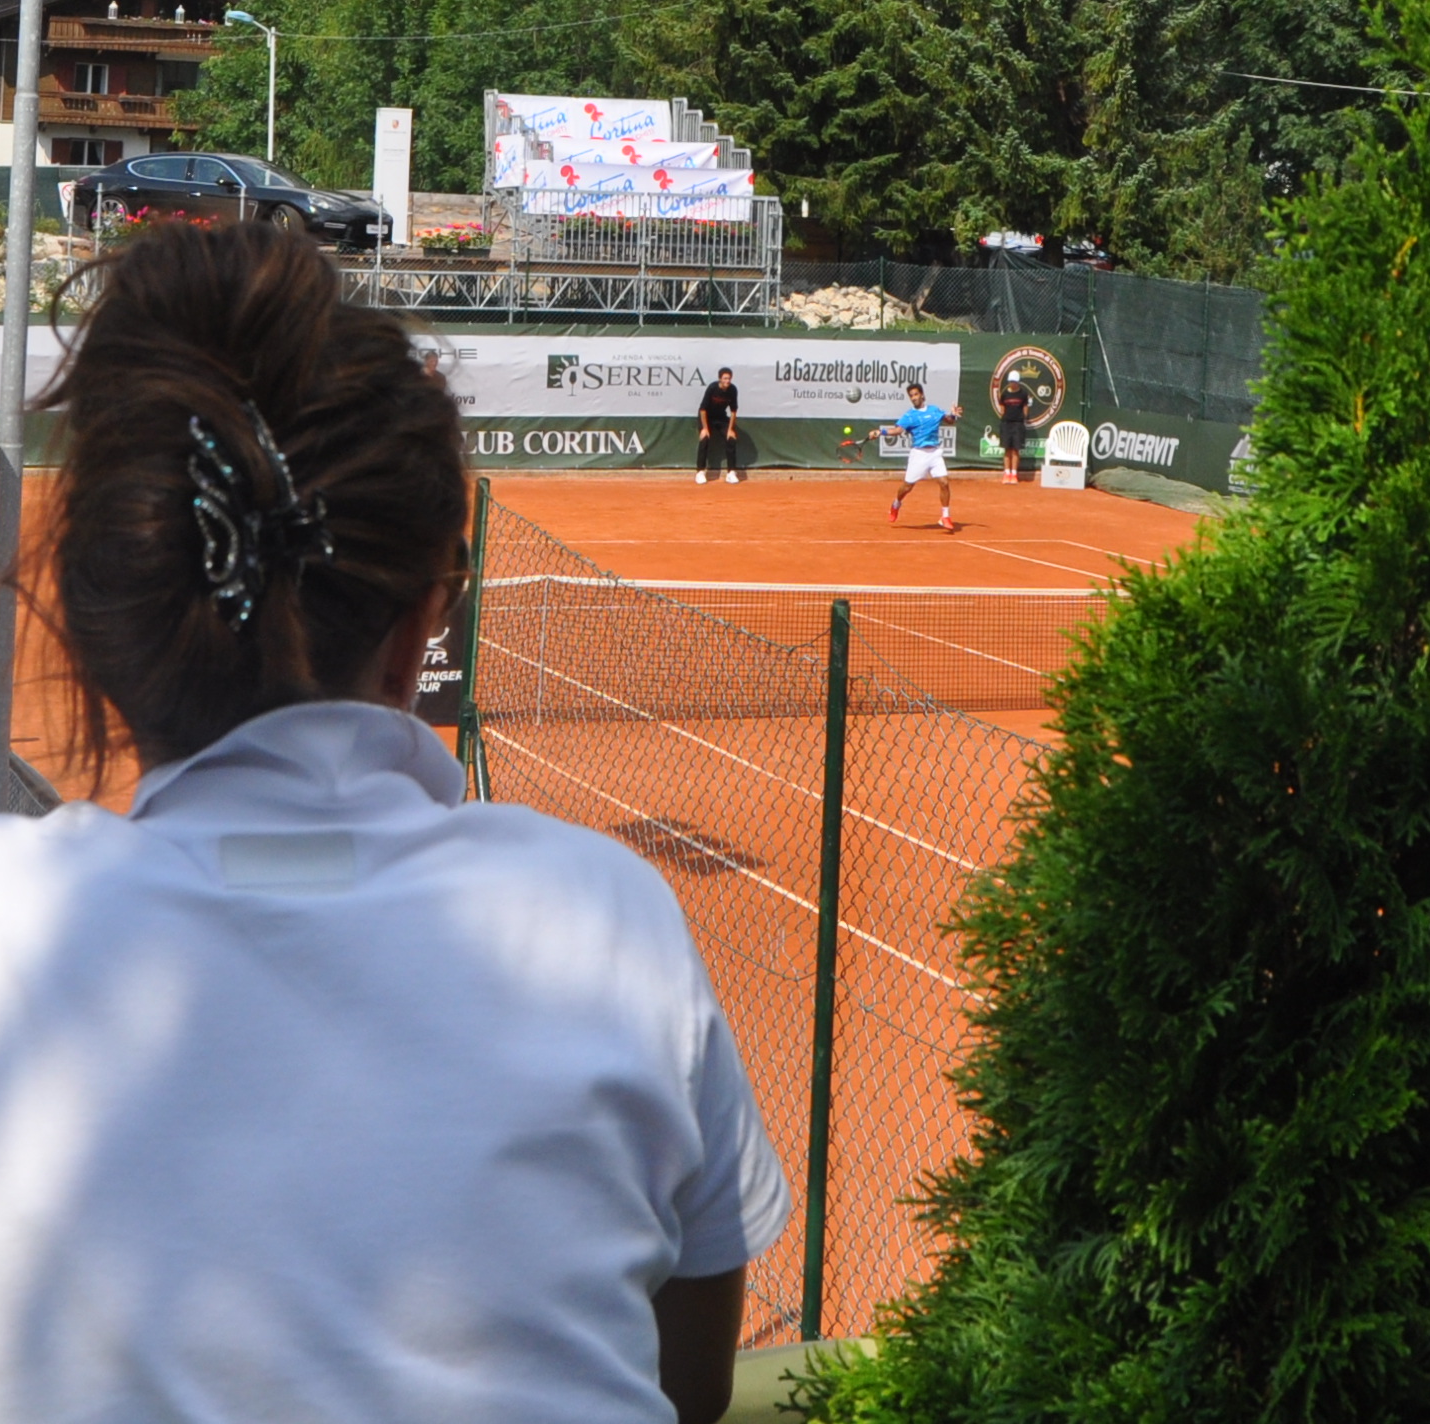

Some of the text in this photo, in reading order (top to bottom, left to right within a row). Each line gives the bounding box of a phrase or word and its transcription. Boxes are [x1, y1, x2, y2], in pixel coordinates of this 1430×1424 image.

[590, 109, 656, 140] Cortina
[564, 173, 634, 213] Cortina
[657, 178, 729, 215] Cortina
[582, 363, 706, 390] SERENA
[793, 357, 853, 383] Gazzetta
[855, 359, 888, 384] dello
[890, 360, 928, 388] Sport
[452, 393, 476, 405] ova
[793, 388, 905, 401] Tutto il rosa della vita
[460, 431, 645, 455] LUB CORTINA
[1114, 430, 1179, 466] ENERVIT
